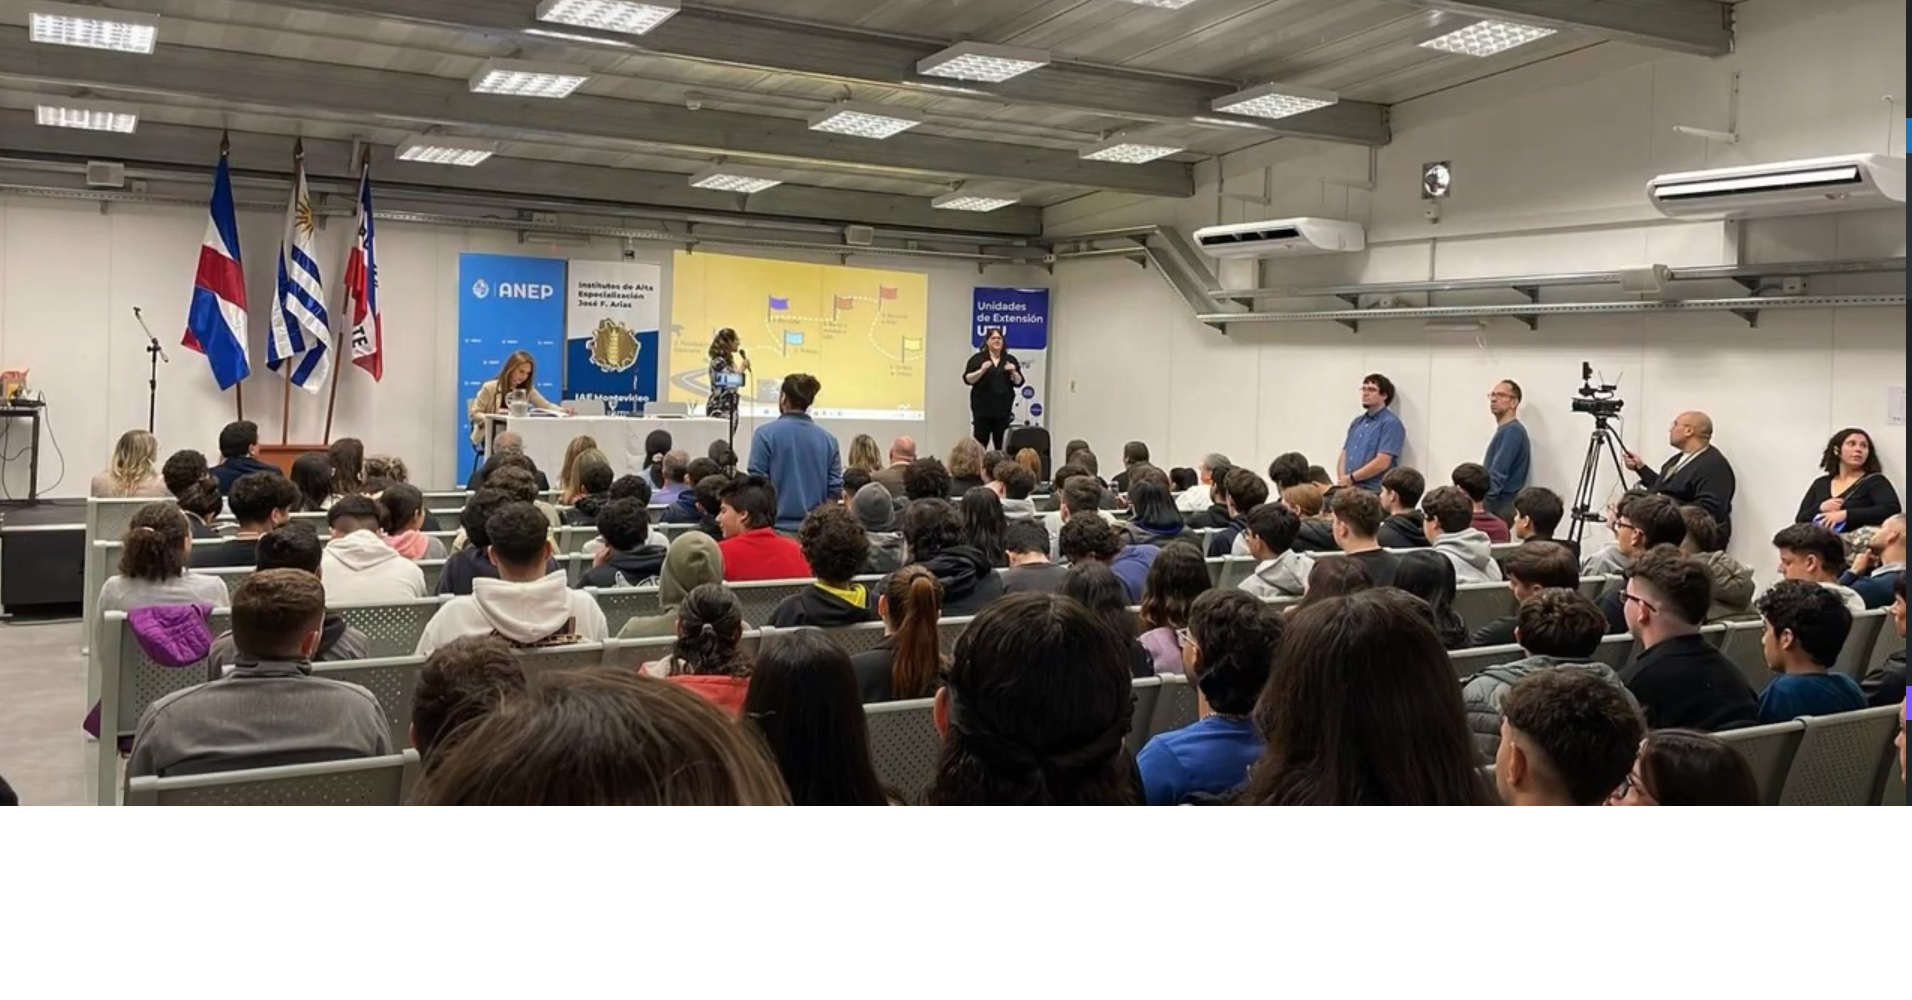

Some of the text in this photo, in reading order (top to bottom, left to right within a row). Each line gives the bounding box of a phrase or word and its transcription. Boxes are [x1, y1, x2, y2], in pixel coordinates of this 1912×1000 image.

[499, 282, 553, 299] ANEP
[578, 281, 620, 290] Institutos
[578, 291, 645, 300] Especialización
[977, 301, 1027, 311] Unidades
[977, 313, 1044, 323] de Extensión
